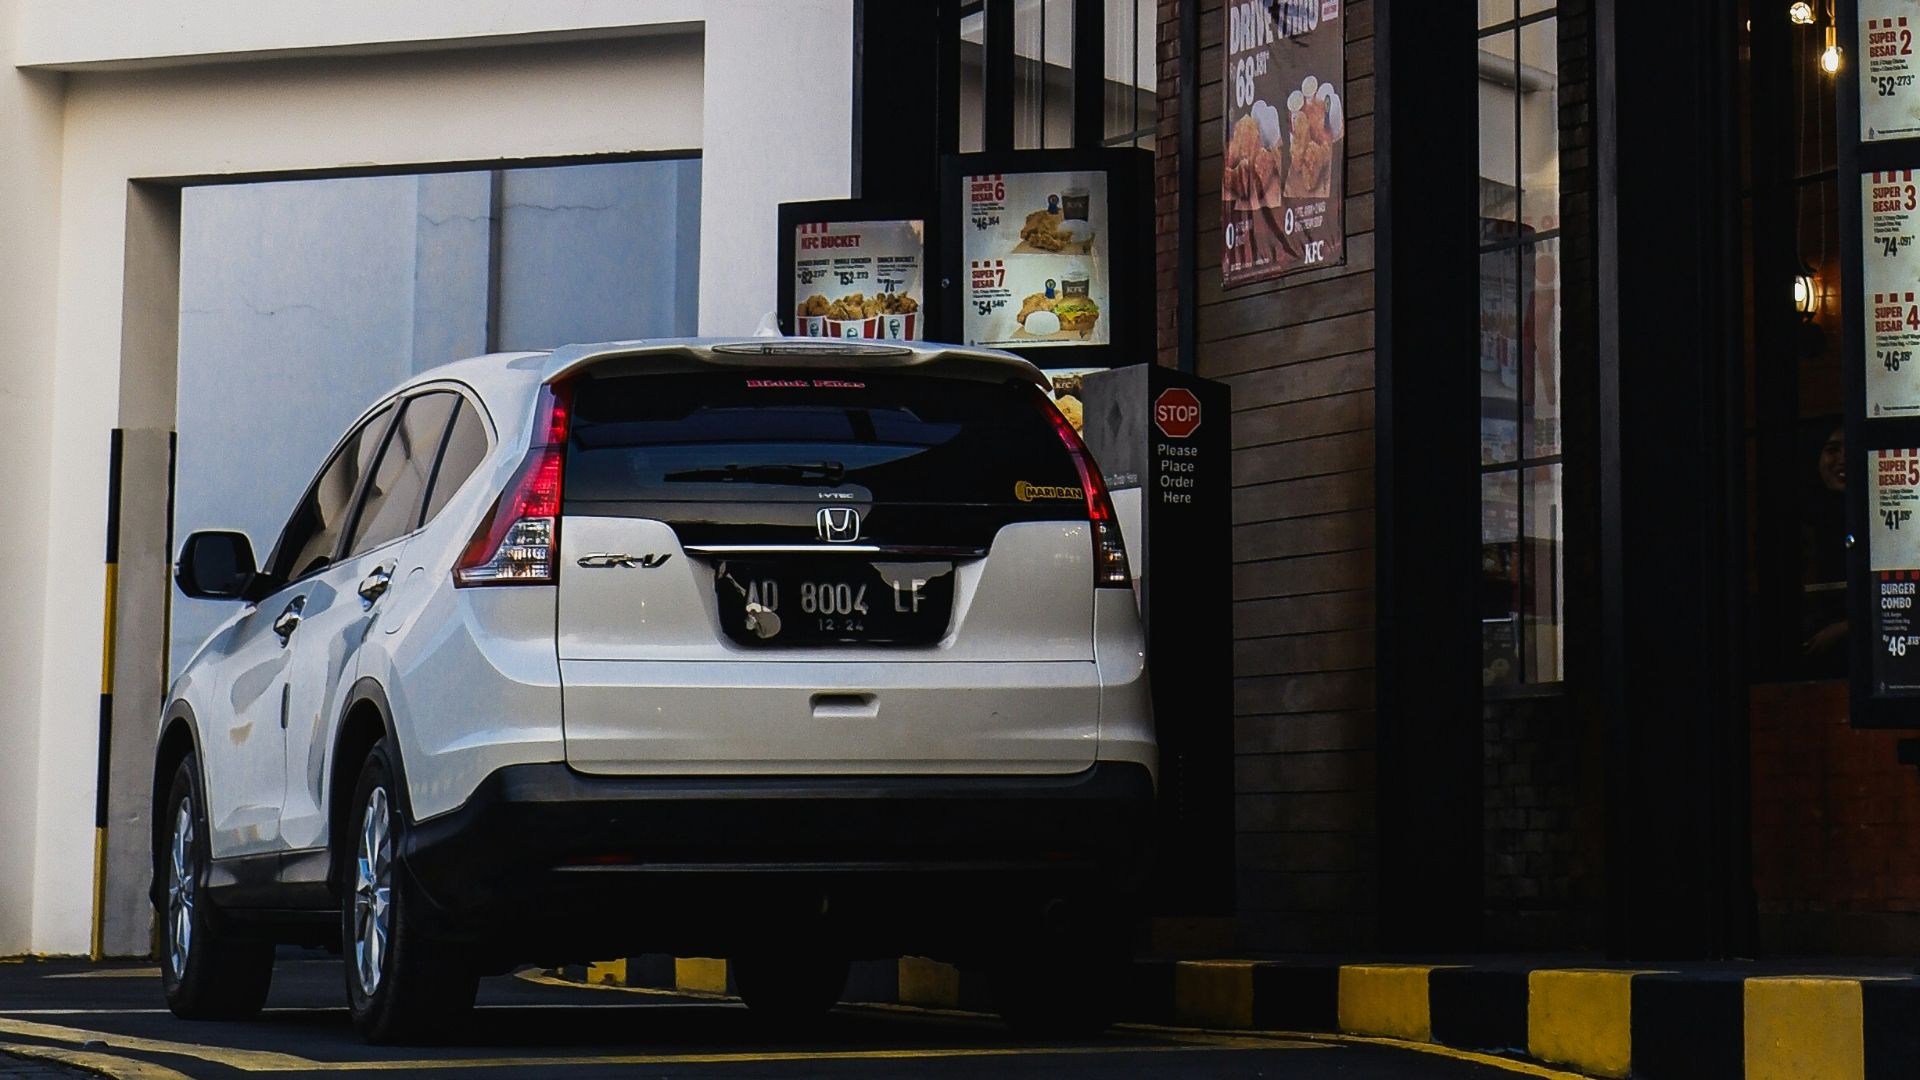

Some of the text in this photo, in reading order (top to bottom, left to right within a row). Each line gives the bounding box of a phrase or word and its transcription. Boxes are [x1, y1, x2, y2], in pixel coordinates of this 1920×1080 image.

[1869, 31, 1896, 44] SUPER
[1900, 30, 1912, 55] 2
[1869, 45, 1897, 58] BESAR
[971, 183, 993, 192] SUPER
[994, 182, 1005, 201] 6
[1872, 186, 1900, 199] SUPER
[1904, 185, 1916, 211] 3
[1873, 200, 1901, 212] BESAR
[821, 235, 861, 249] BUCKET
[1304, 239, 1325, 264] KFC
[971, 270, 994, 279] SUPER
[995, 269, 1005, 287] 7
[1874, 306, 1902, 319] SUPER
[1906, 305, 1920, 331] 4
[1875, 320, 1903, 332] BESAR
[1158, 405, 1198, 422] STOP
[1157, 444, 1197, 456] Please
[1161, 460, 1195, 472] Place
[1878, 460, 1906, 472] SUPER
[1908, 459, 1920, 485] 5
[1160, 476, 1194, 487] Order
[1878, 474, 1906, 486] BESAR
[1056, 487, 1082, 498] BAN
[1163, 492, 1192, 503] Here
[577, 552, 672, 569] CR-V
[1881, 582, 1916, 595] BURGER
[747, 579, 927, 616] AD 8004 LF
[1881, 597, 1912, 609] COMBO
